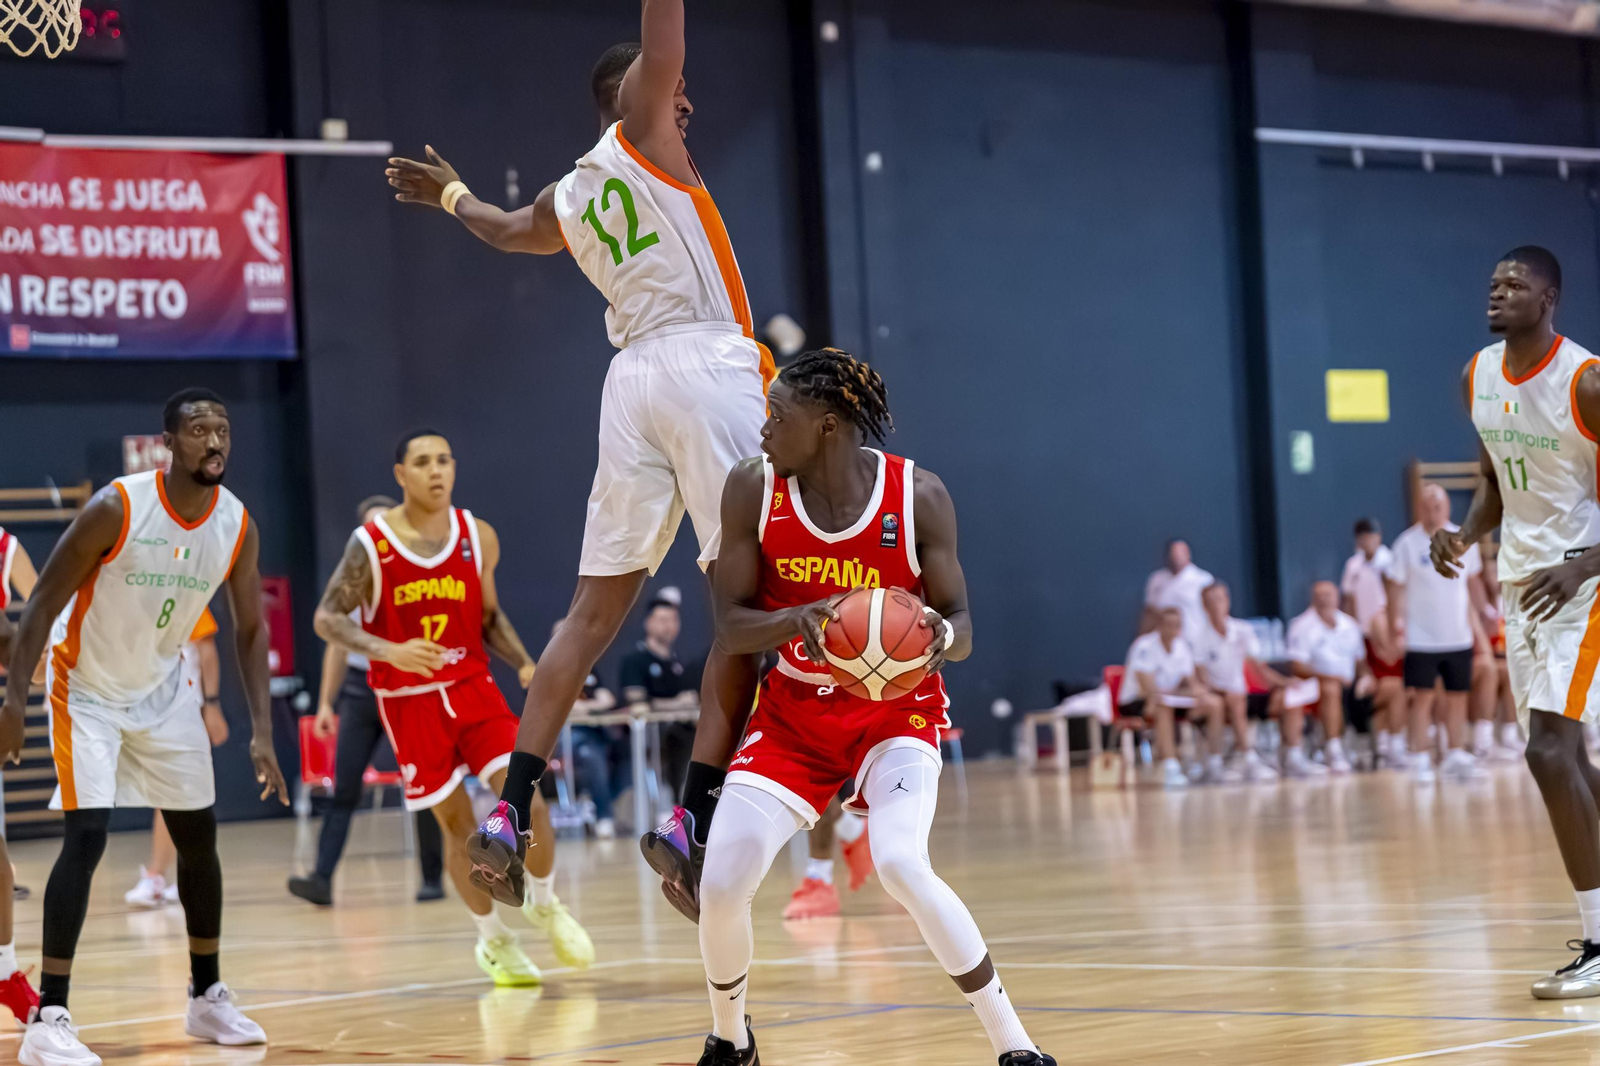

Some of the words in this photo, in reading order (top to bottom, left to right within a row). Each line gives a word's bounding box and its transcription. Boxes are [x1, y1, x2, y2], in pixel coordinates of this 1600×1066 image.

[68, 176, 104, 211] SE
[110, 177, 207, 213] JUEGA
[581, 177, 660, 266] 12
[40, 223, 77, 257] SE
[81, 226, 222, 260] DISFRUTA
[19, 274, 188, 319] RESPETO
[1504, 457, 1528, 491] 11
[883, 532, 896, 540] FIBA
[125, 570, 166, 587] CÔTE
[394, 574, 466, 606] ESPAÑA
[776, 556, 880, 590] ESPAÑA
[157, 598, 175, 629] 8
[420, 614, 448, 642] 17
